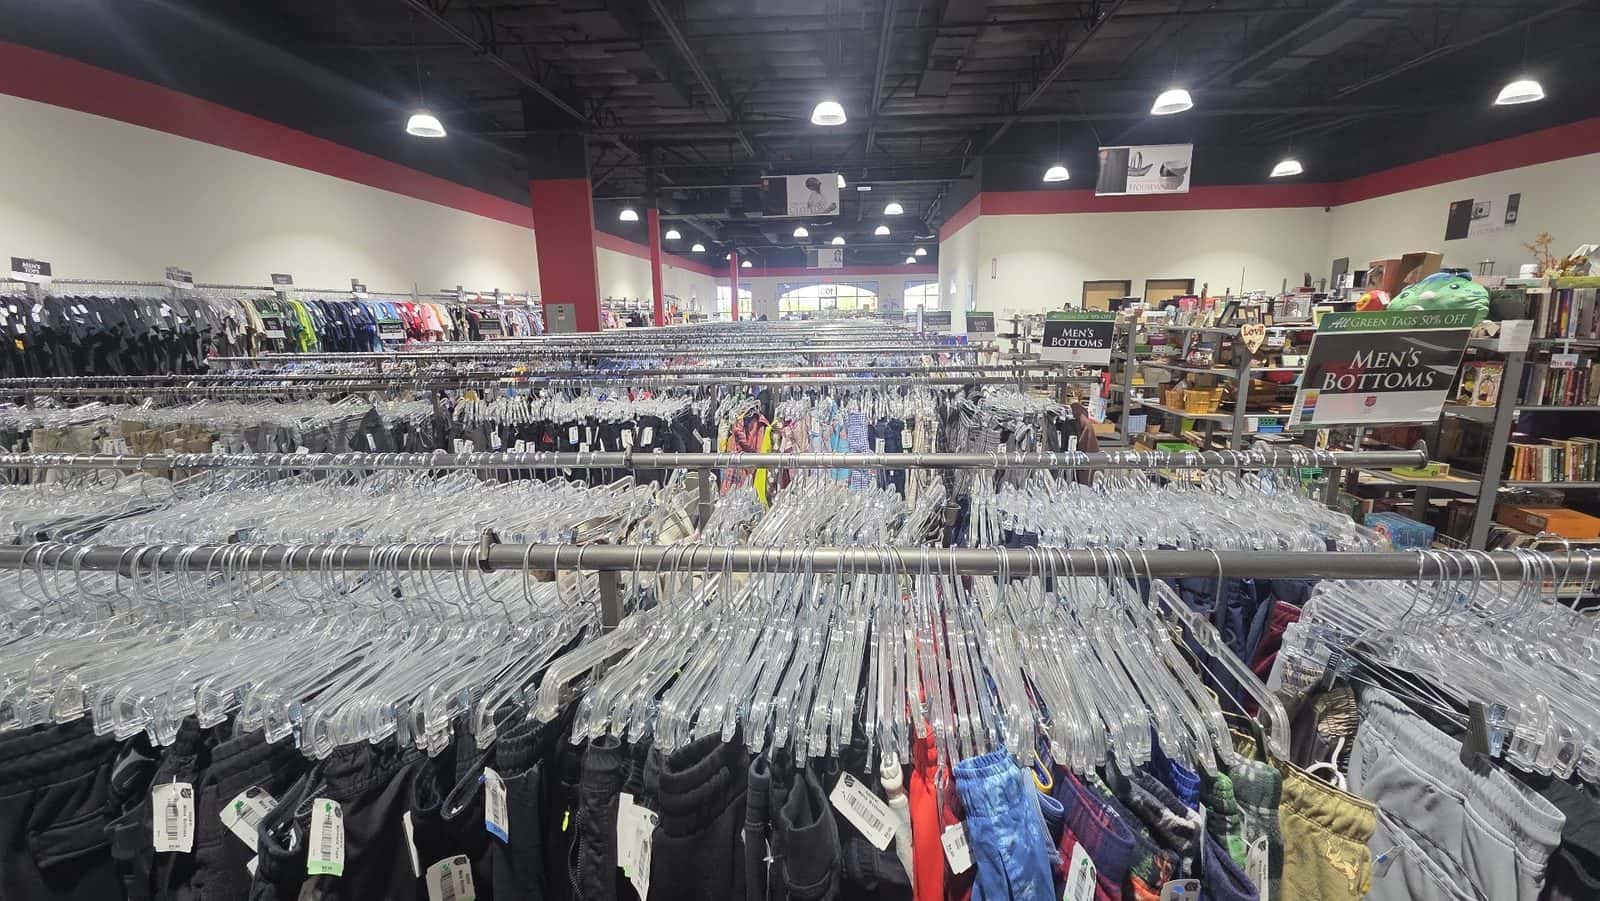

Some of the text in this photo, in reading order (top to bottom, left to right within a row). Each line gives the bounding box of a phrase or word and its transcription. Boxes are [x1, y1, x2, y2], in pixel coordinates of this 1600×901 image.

[1329, 314, 1467, 328] All GREEN TAGS 50% OFF
[1062, 327, 1095, 338] MEN'S
[1051, 336, 1104, 348] BOTTOMS
[1349, 347, 1422, 369] MEN'S
[1322, 371, 1436, 391] BOTTOMS
